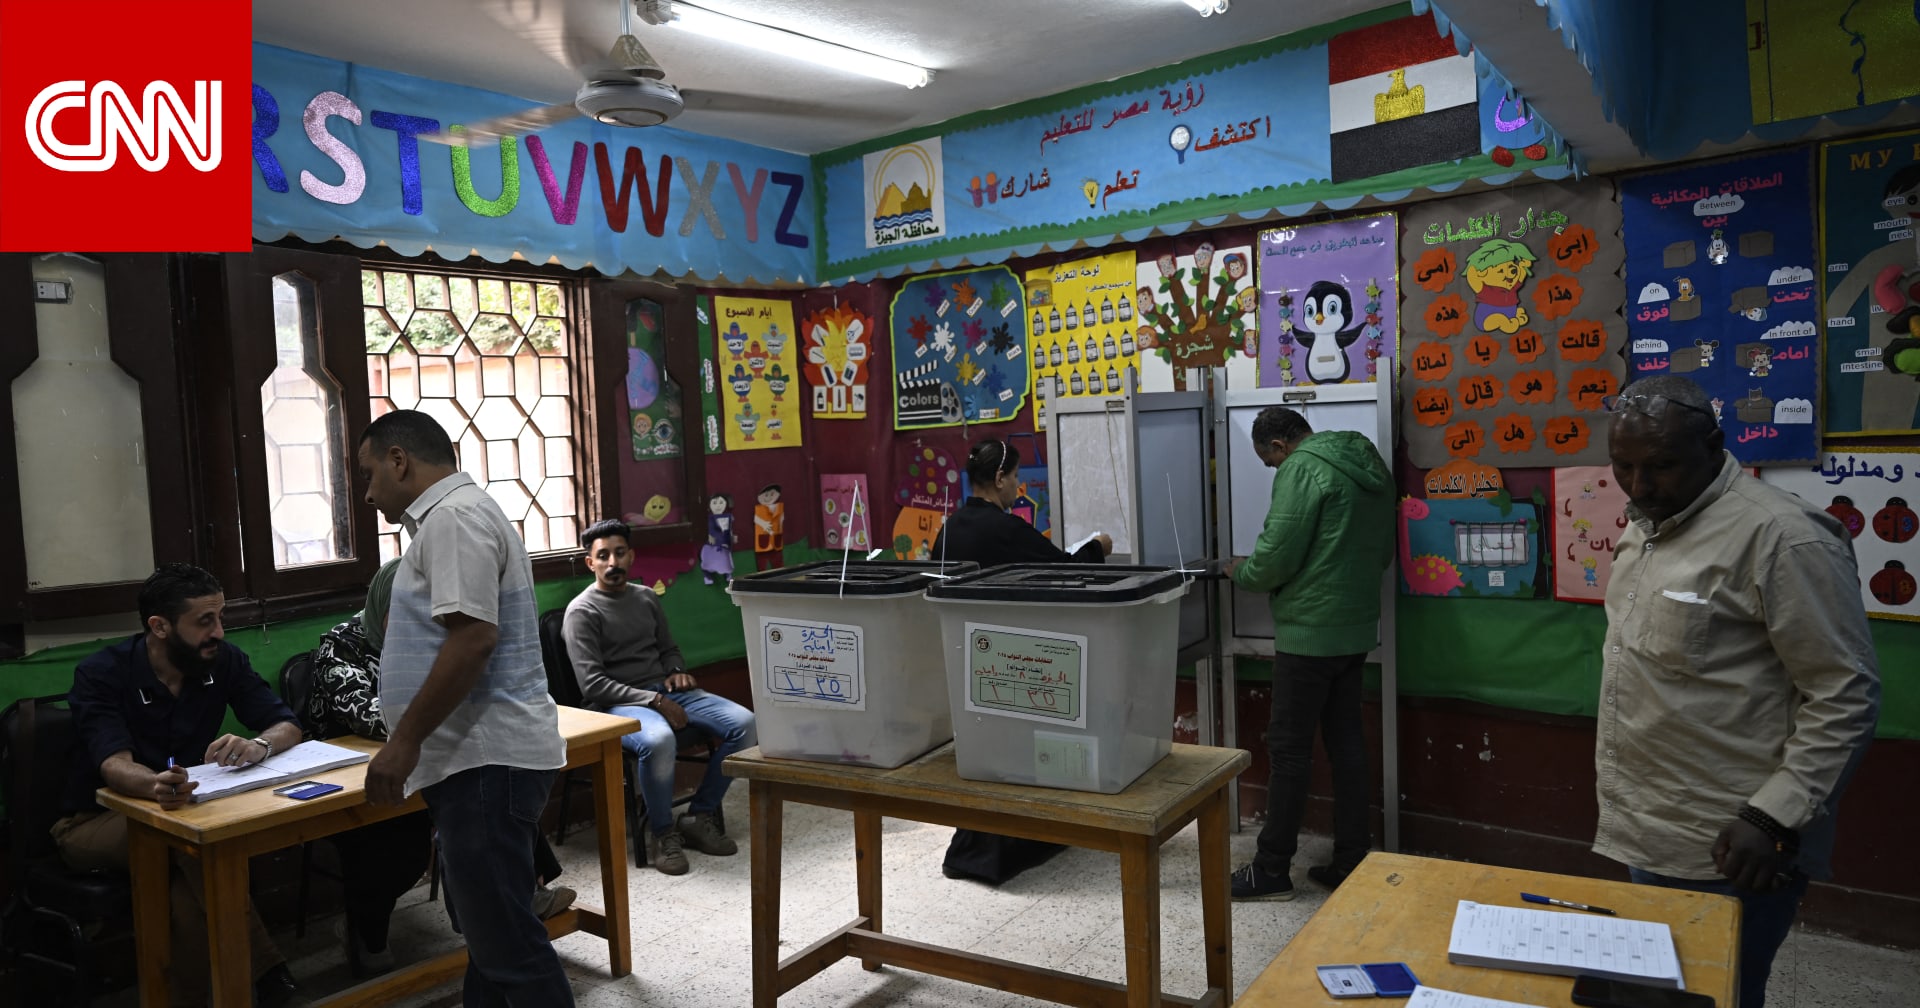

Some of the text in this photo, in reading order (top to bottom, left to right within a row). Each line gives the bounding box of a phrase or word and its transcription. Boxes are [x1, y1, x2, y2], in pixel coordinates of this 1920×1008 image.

[1040, 81, 1204, 157] رؤية مصر للتعليم
[1194, 115, 1271, 152] اكتشف
[300, 90, 367, 205] S
[370, 110, 440, 216] T
[450, 124, 519, 218] U
[526, 134, 588, 226] V
[594, 141, 672, 237] W
[676, 156, 726, 239] X
[728, 161, 769, 243] Y
[771, 171, 809, 248] Z
[1000, 167, 1051, 198] شارك
[1102, 169, 1140, 211] تعلم
[1700, 200, 1736, 210] Between
[1888, 197, 1904, 206] eye
[1423, 207, 1568, 245] جدار الكلمات
[1877, 219, 1908, 229] mouth
[875, 223, 939, 245] محافظة الجيزة
[1891, 229, 1913, 240] neck
[1054, 264, 1099, 283] لوحة التعزيز
[1776, 274, 1801, 284] under
[1548, 289, 1572, 304] هذا
[1773, 286, 1812, 303] تحت
[1435, 306, 1459, 322] هذه
[1637, 302, 1669, 322] فوق
[1830, 318, 1853, 326] hand
[1562, 330, 1600, 349] قالت
[1779, 329, 1801, 338] front
[1803, 327, 1813, 336] of
[1175, 334, 1214, 359] شجرة
[1474, 341, 1490, 358] يا
[1516, 336, 1536, 354] انا
[1635, 341, 1662, 349] behind
[1856, 348, 1881, 356] small
[1417, 354, 1447, 371] لماذا
[1637, 357, 1669, 372] خلف
[1842, 360, 1883, 371] intestine
[1465, 381, 1494, 404] قال
[1520, 381, 1542, 395] هو
[1578, 380, 1607, 400] نعم
[900, 392, 939, 408] Colors
[1781, 405, 1807, 414] inside
[1504, 423, 1524, 441] هل
[1737, 425, 1778, 443] داخل
[1427, 474, 1499, 498] تحليل الكلمات
[918, 515, 932, 533] أنا
